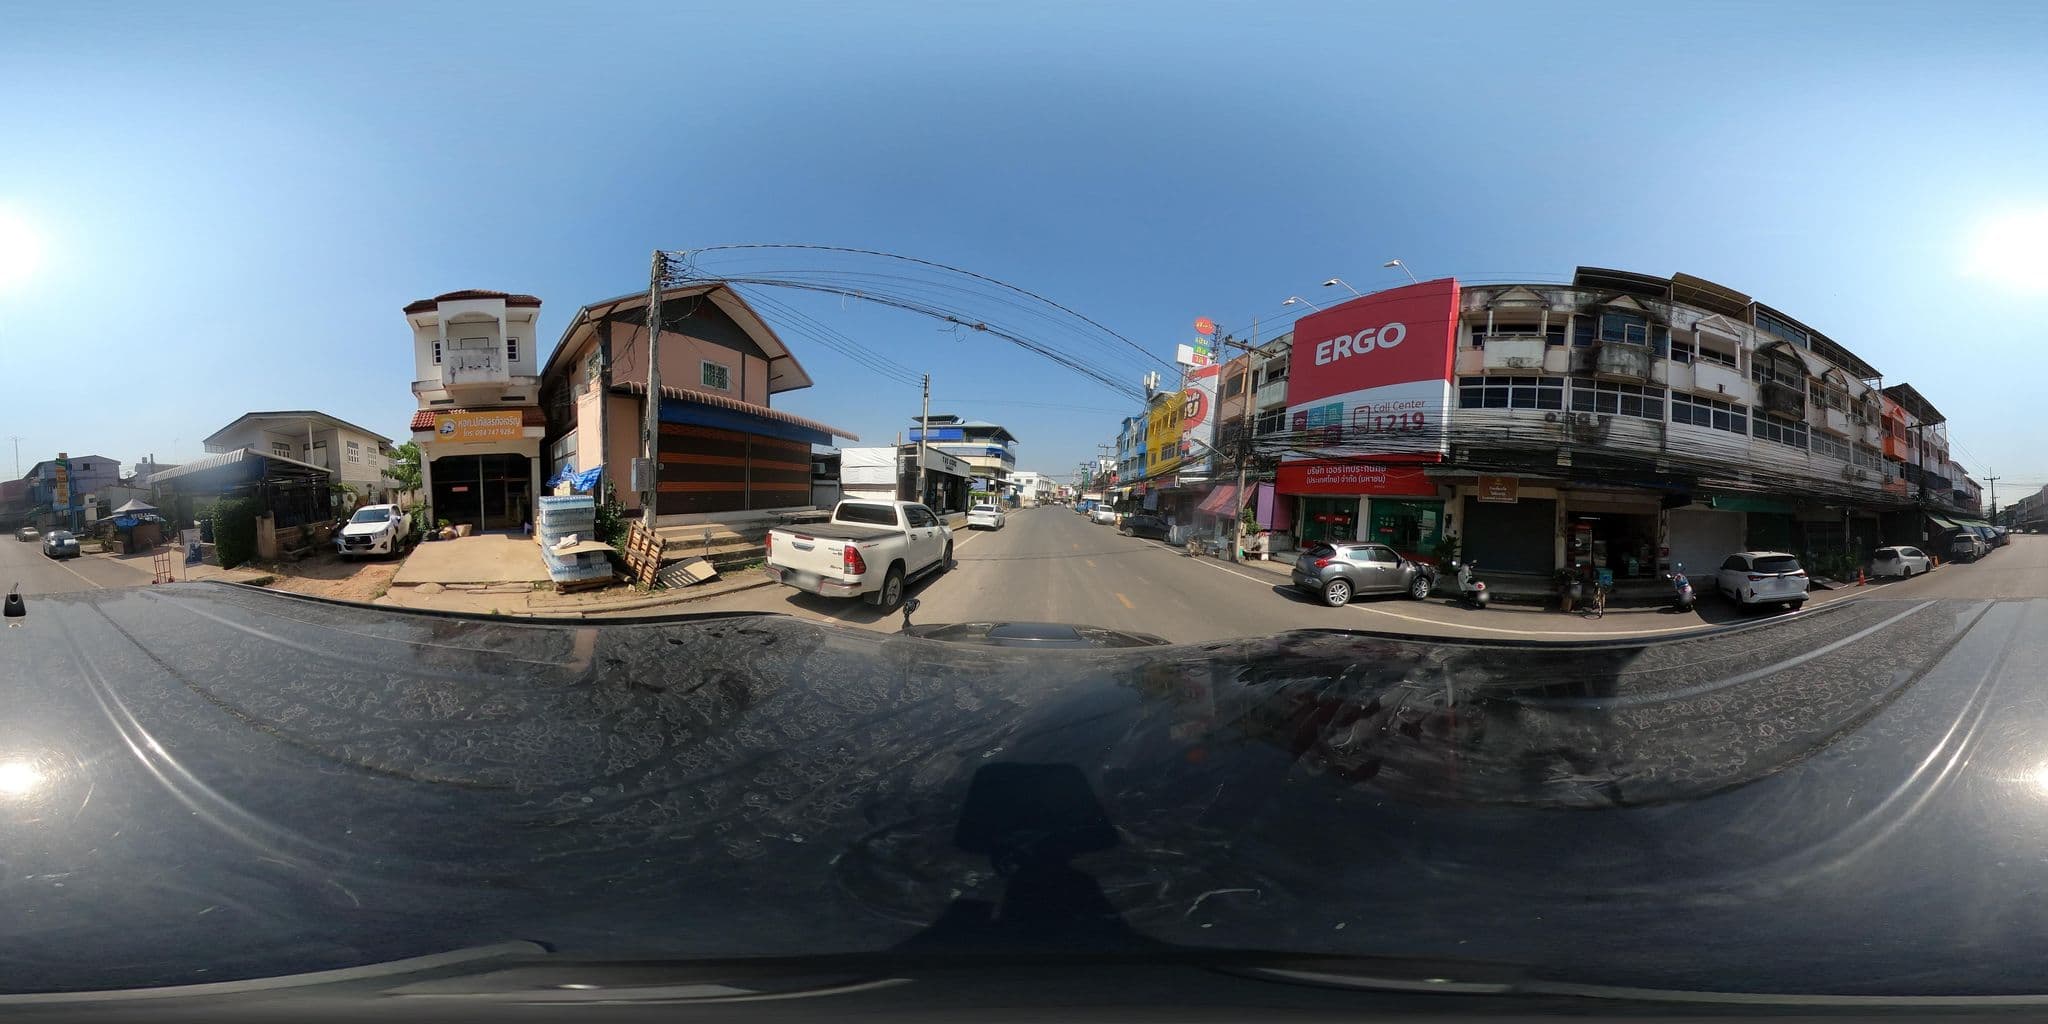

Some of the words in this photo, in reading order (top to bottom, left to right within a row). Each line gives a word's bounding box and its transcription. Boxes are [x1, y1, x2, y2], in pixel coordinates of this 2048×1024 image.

[1315, 322, 1407, 366] ERGO
[1374, 402, 1391, 413] Call
[1393, 400, 1425, 410] Center
